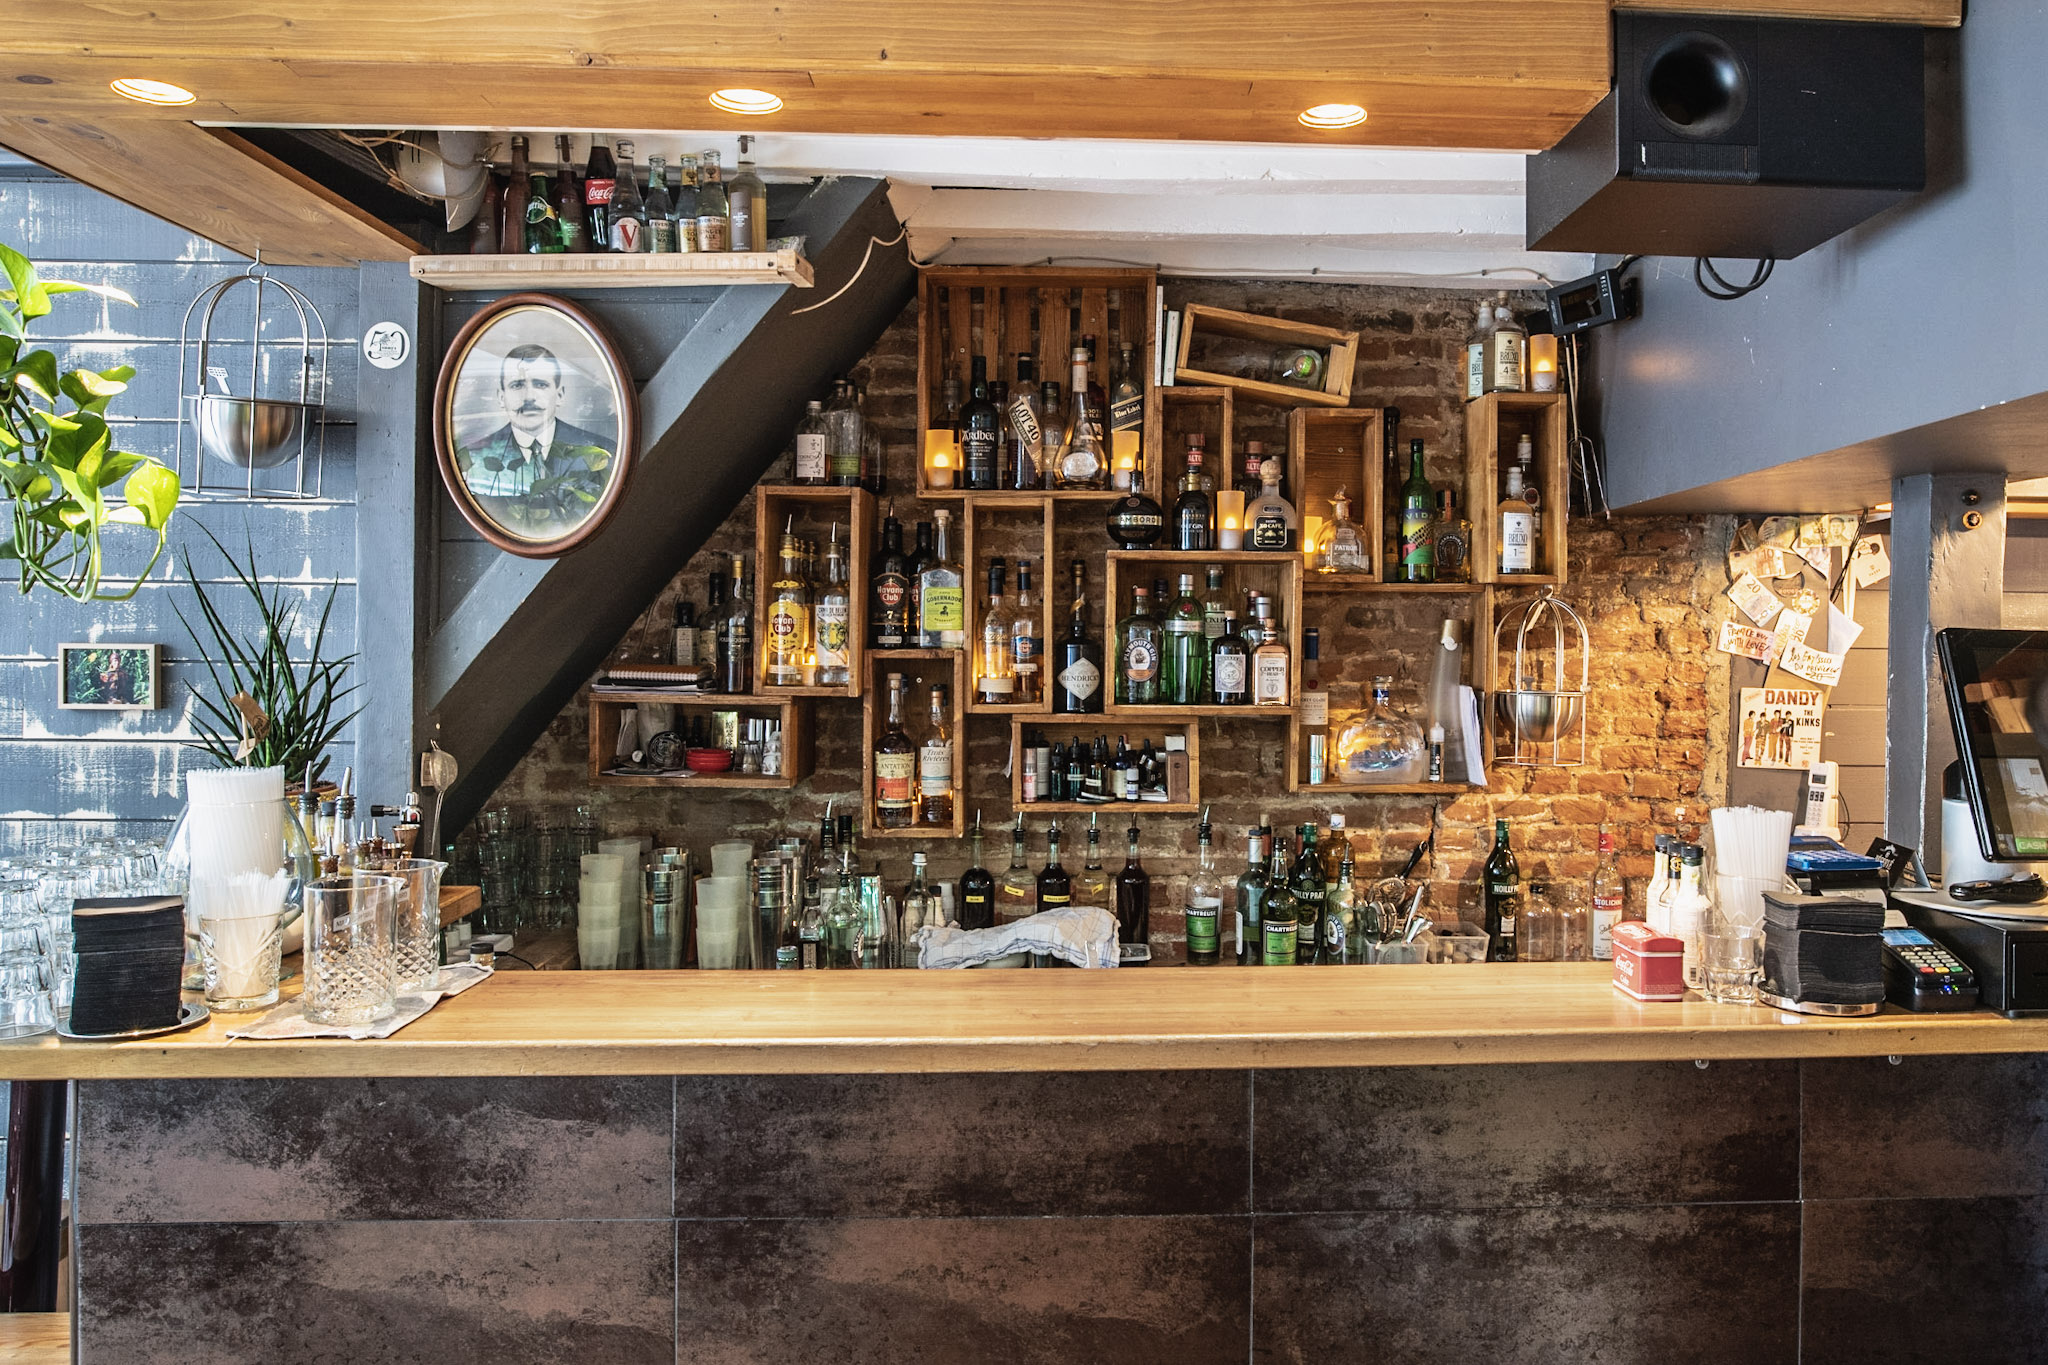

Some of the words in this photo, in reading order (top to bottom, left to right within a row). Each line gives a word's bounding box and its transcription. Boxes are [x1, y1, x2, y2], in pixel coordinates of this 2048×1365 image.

[619, 224, 637, 248] V
[1503, 366, 1509, 374] 4
[1014, 401, 1034, 424] LOT
[1026, 424, 1040, 441] 40
[877, 585, 904, 594] Havana
[1746, 578, 1761, 594] 20
[882, 593, 899, 601] Club
[886, 610, 894, 620] 7
[1123, 640, 1152, 661] PLYMOUTH
[1149, 647, 1158, 661] GIN
[1060, 674, 1099, 682] HENDRICK
[1764, 689, 1820, 706] DANDY
[1796, 717, 1821, 727] KINKS
[2019, 841, 2047, 850] CASH
[1494, 884, 1513, 893] NOILLY
[1310, 891, 1325, 899] PRAT
[1186, 908, 1217, 916] CHARTREUSE
[1266, 925, 1297, 933] CHARTREUS
